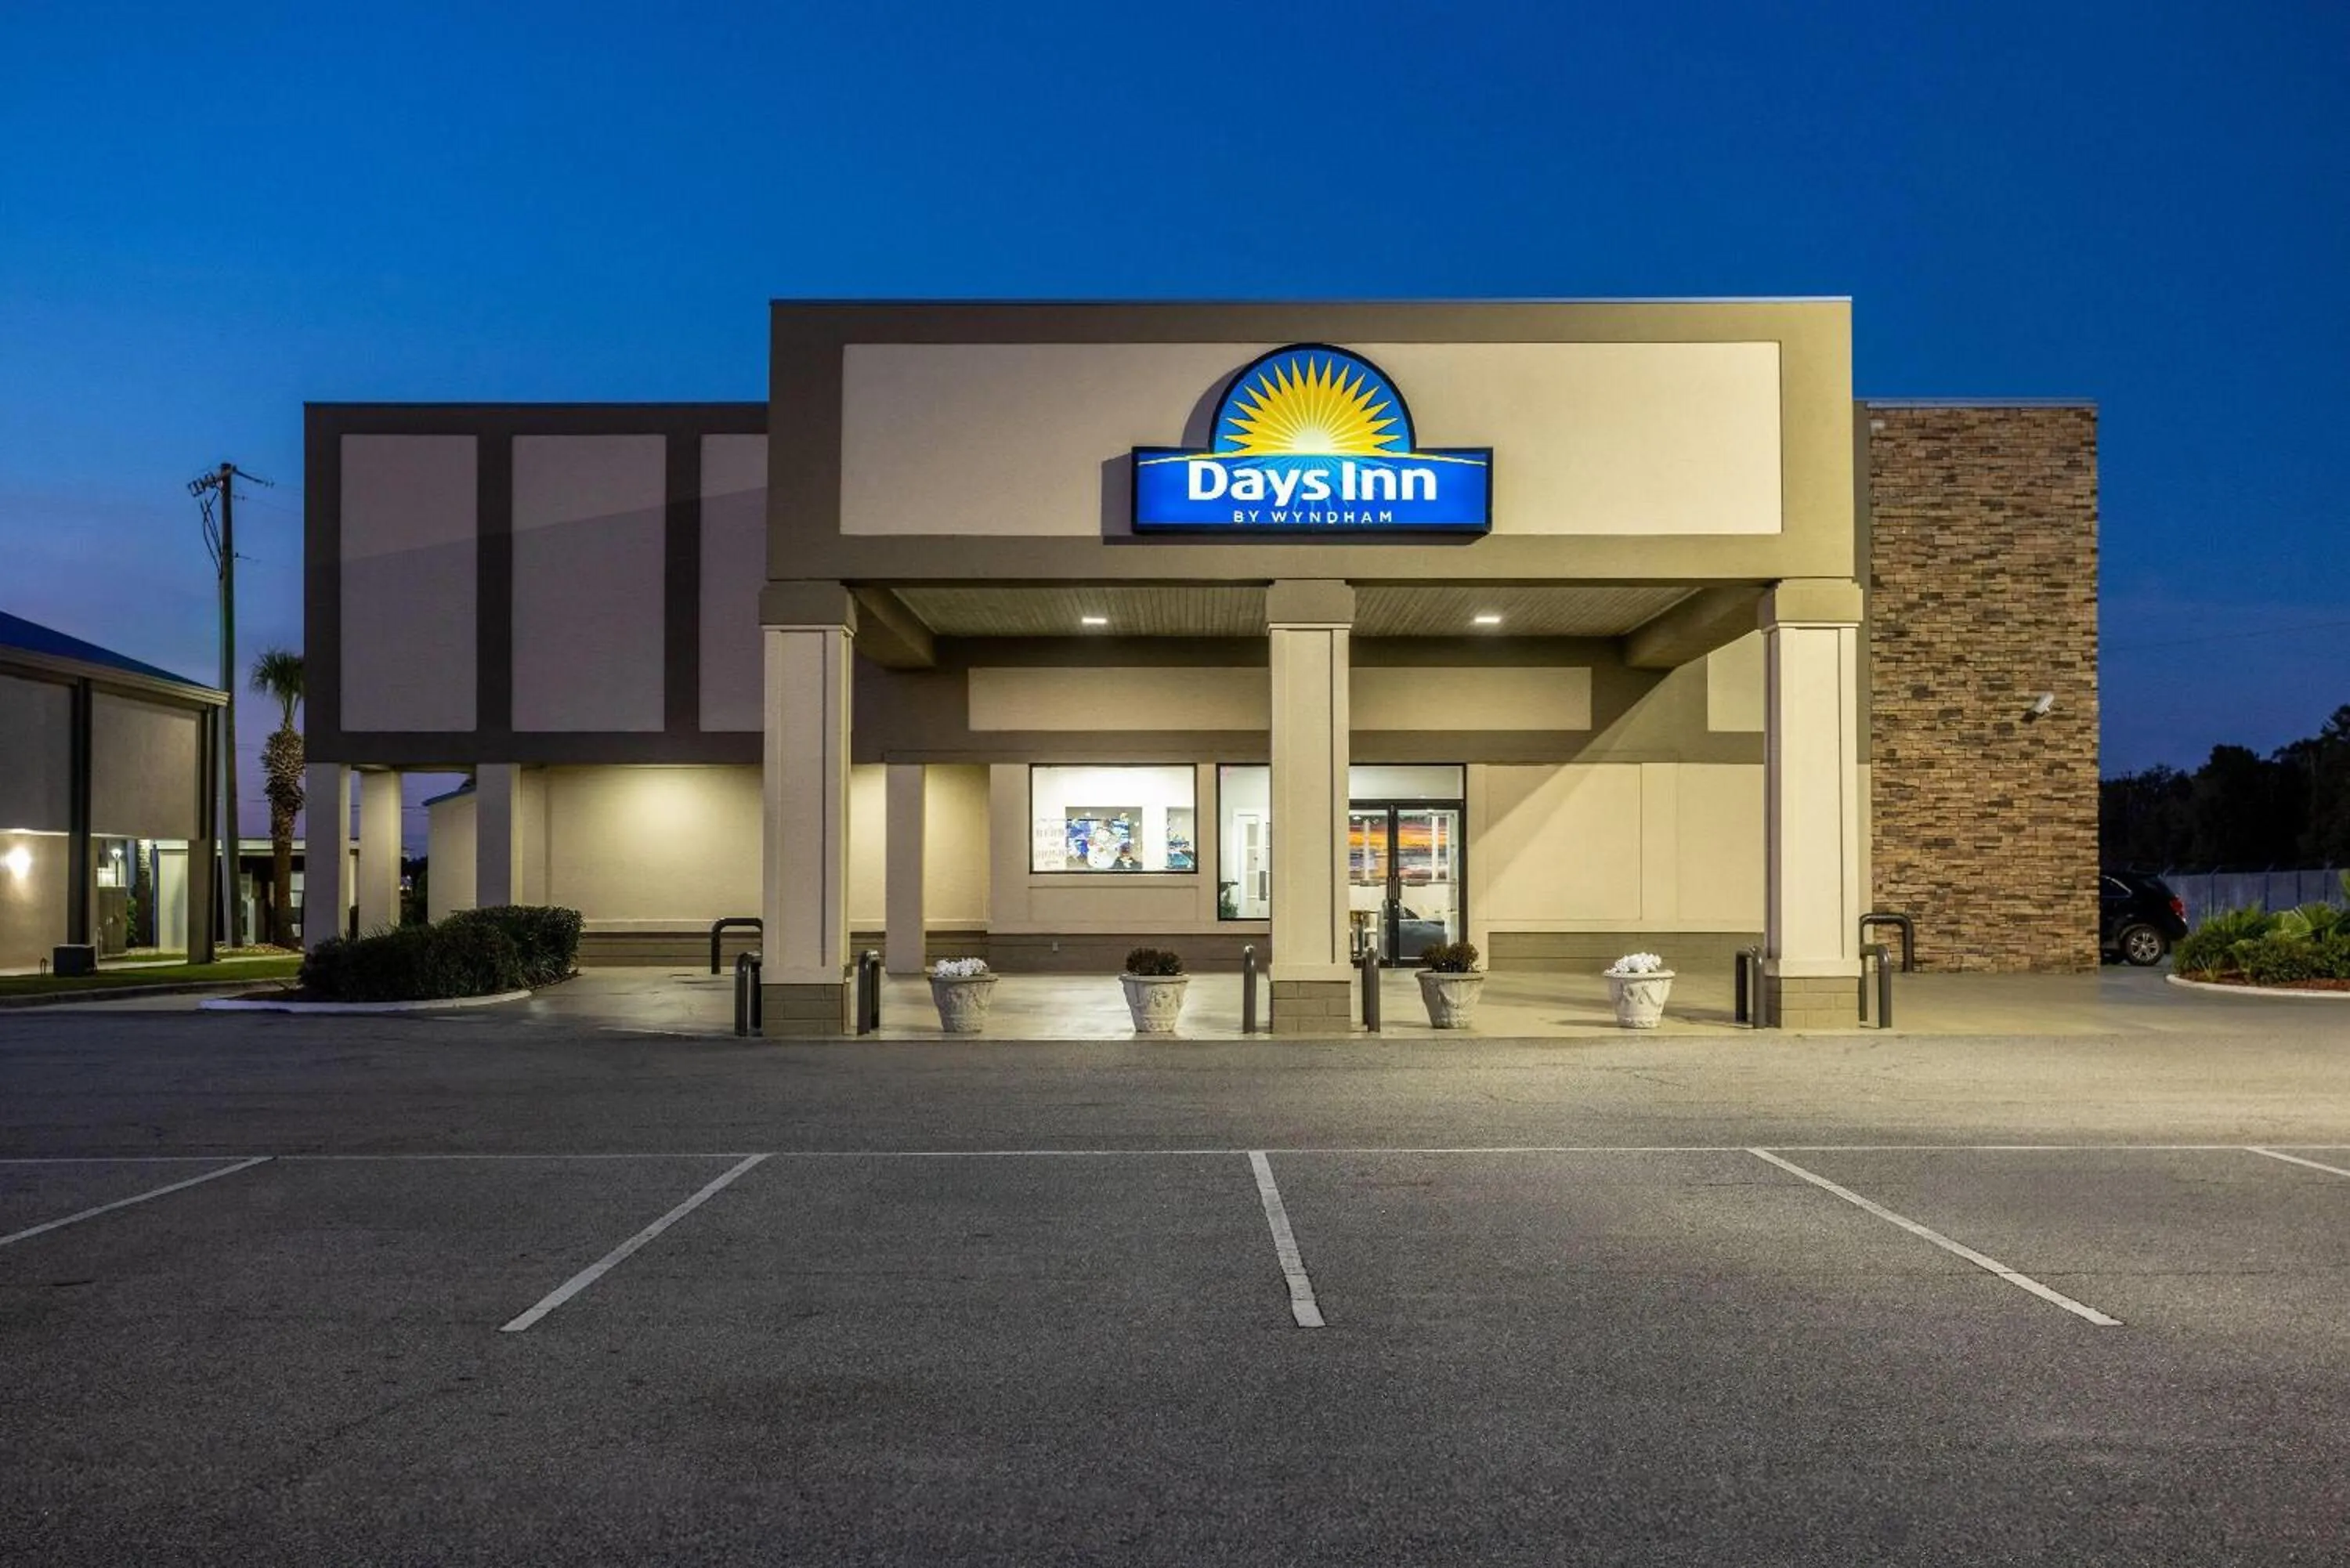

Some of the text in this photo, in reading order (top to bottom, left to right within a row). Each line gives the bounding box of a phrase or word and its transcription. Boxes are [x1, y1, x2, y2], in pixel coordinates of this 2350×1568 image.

[1188, 461, 1437, 507] Days Inn
[1234, 511, 1392, 524] BY WYNDHAM
